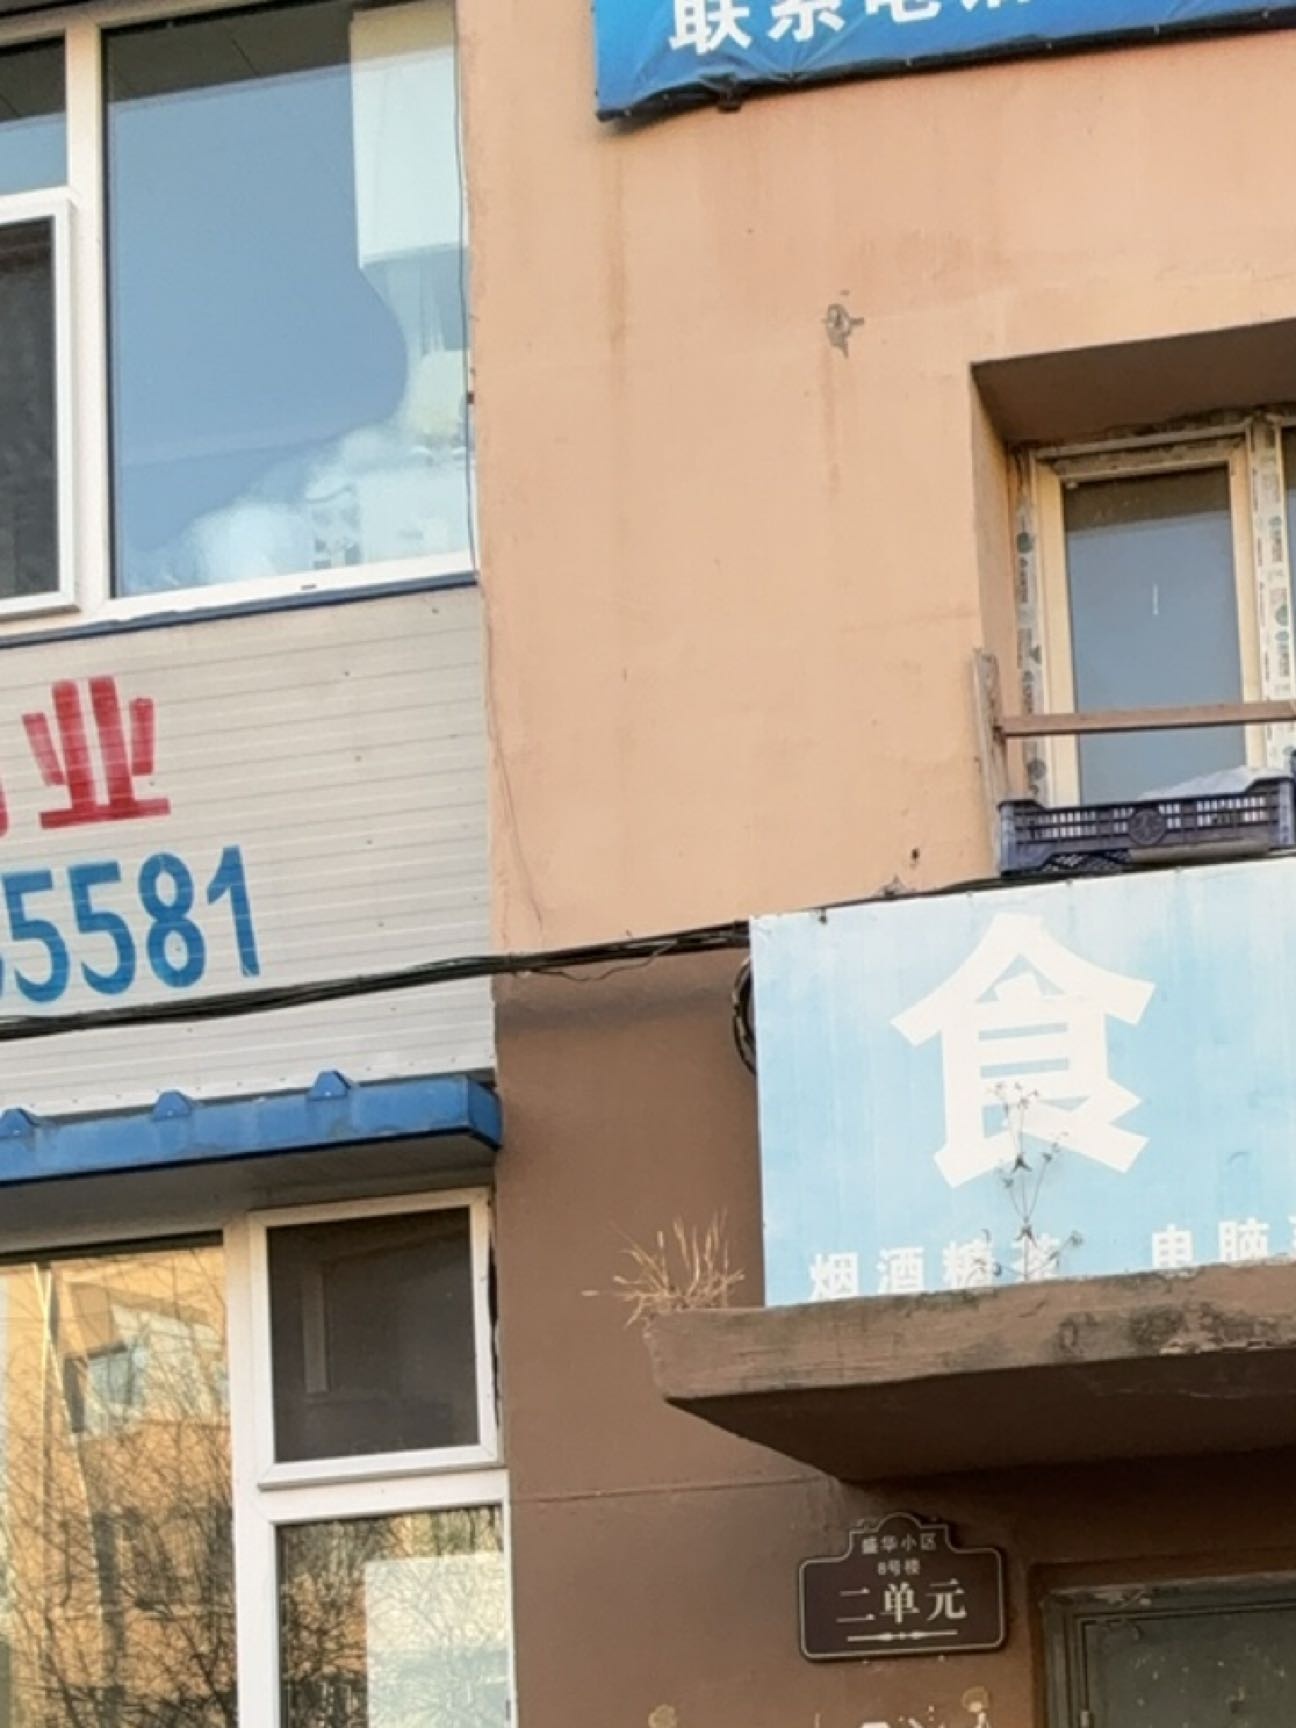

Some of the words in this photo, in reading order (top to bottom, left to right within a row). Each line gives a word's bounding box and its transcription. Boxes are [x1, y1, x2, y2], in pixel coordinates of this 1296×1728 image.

[668, 0, 1028, 54] 联系
[0, 676, 171, 830] 业
[0, 844, 260, 1003] 5581
[835, 1577, 968, 1624] 二单元
